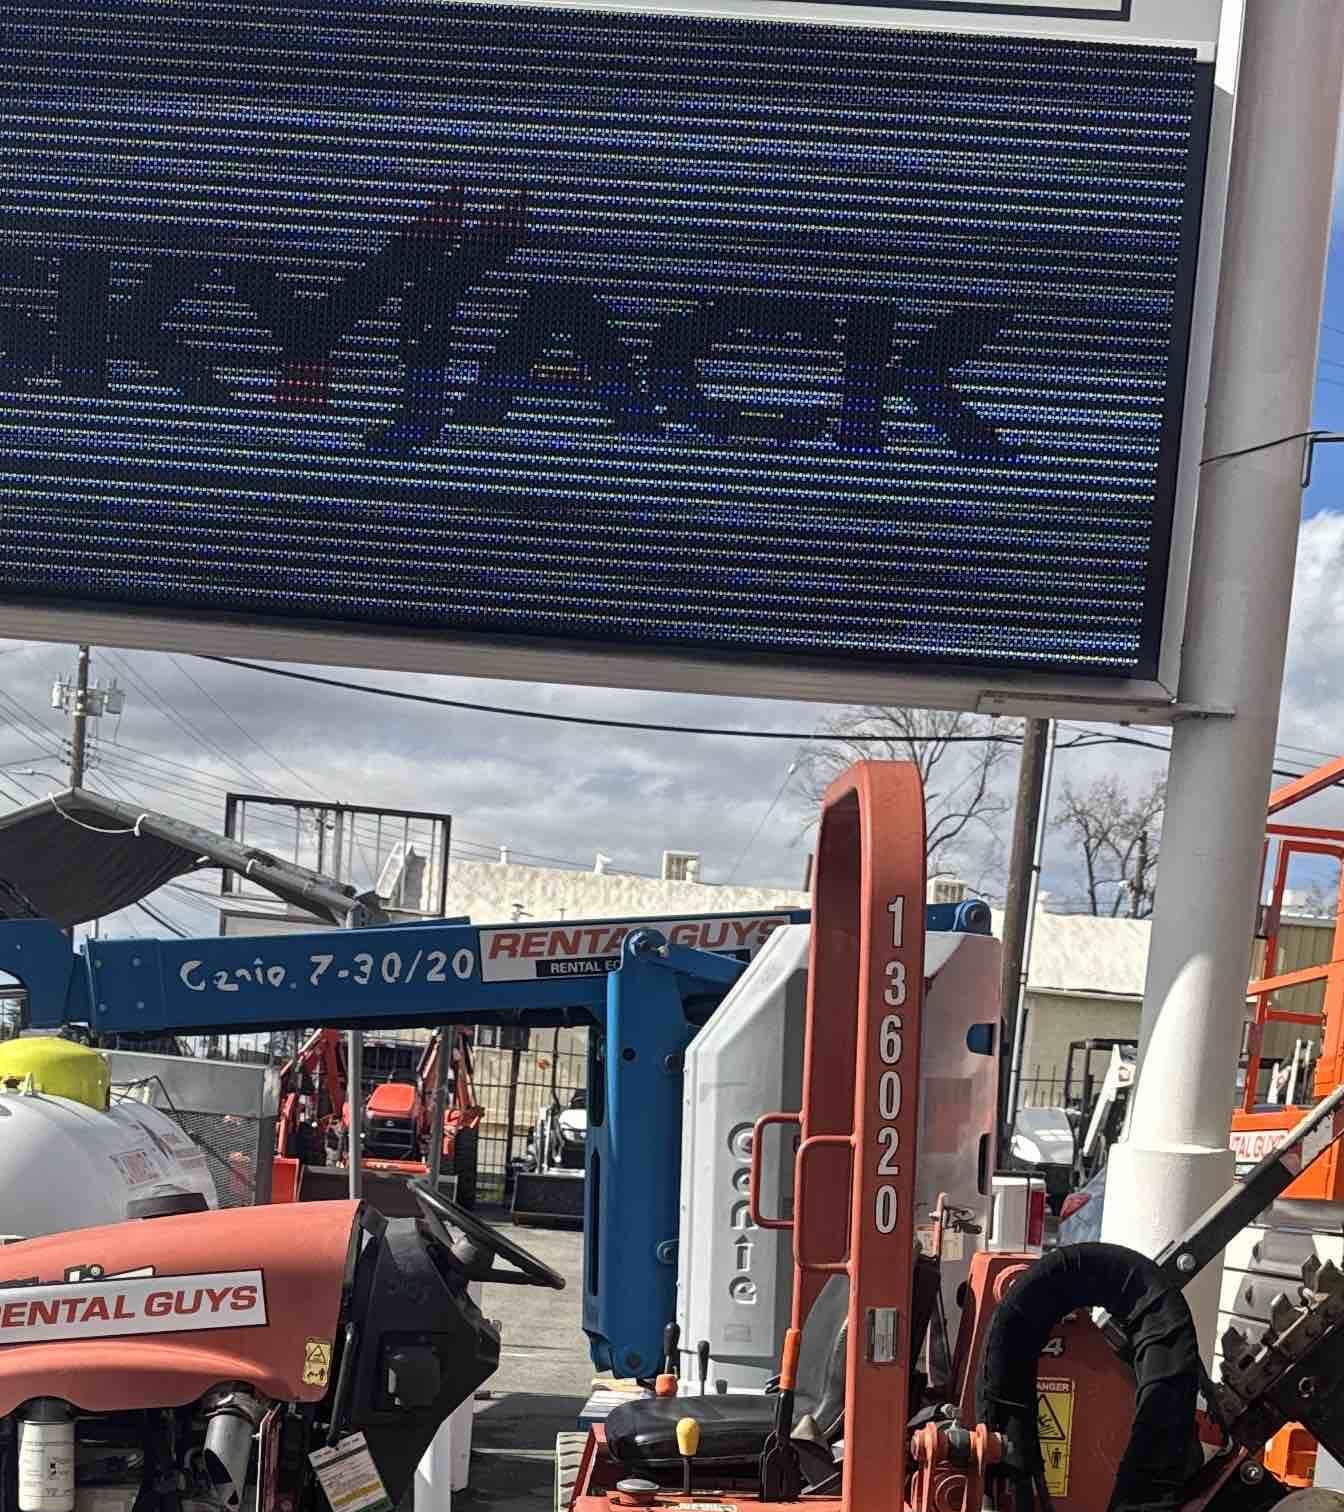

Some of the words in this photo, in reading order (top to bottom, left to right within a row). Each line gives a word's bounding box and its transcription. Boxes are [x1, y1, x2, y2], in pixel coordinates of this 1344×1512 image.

[488, 927, 632, 960] RENTA
[550, 960, 601, 975] RENTAL
[874, 896, 907, 1235] 136020
[144, 1285, 258, 1318] GUYS
[1036, 1382, 1070, 1392] ANGER
